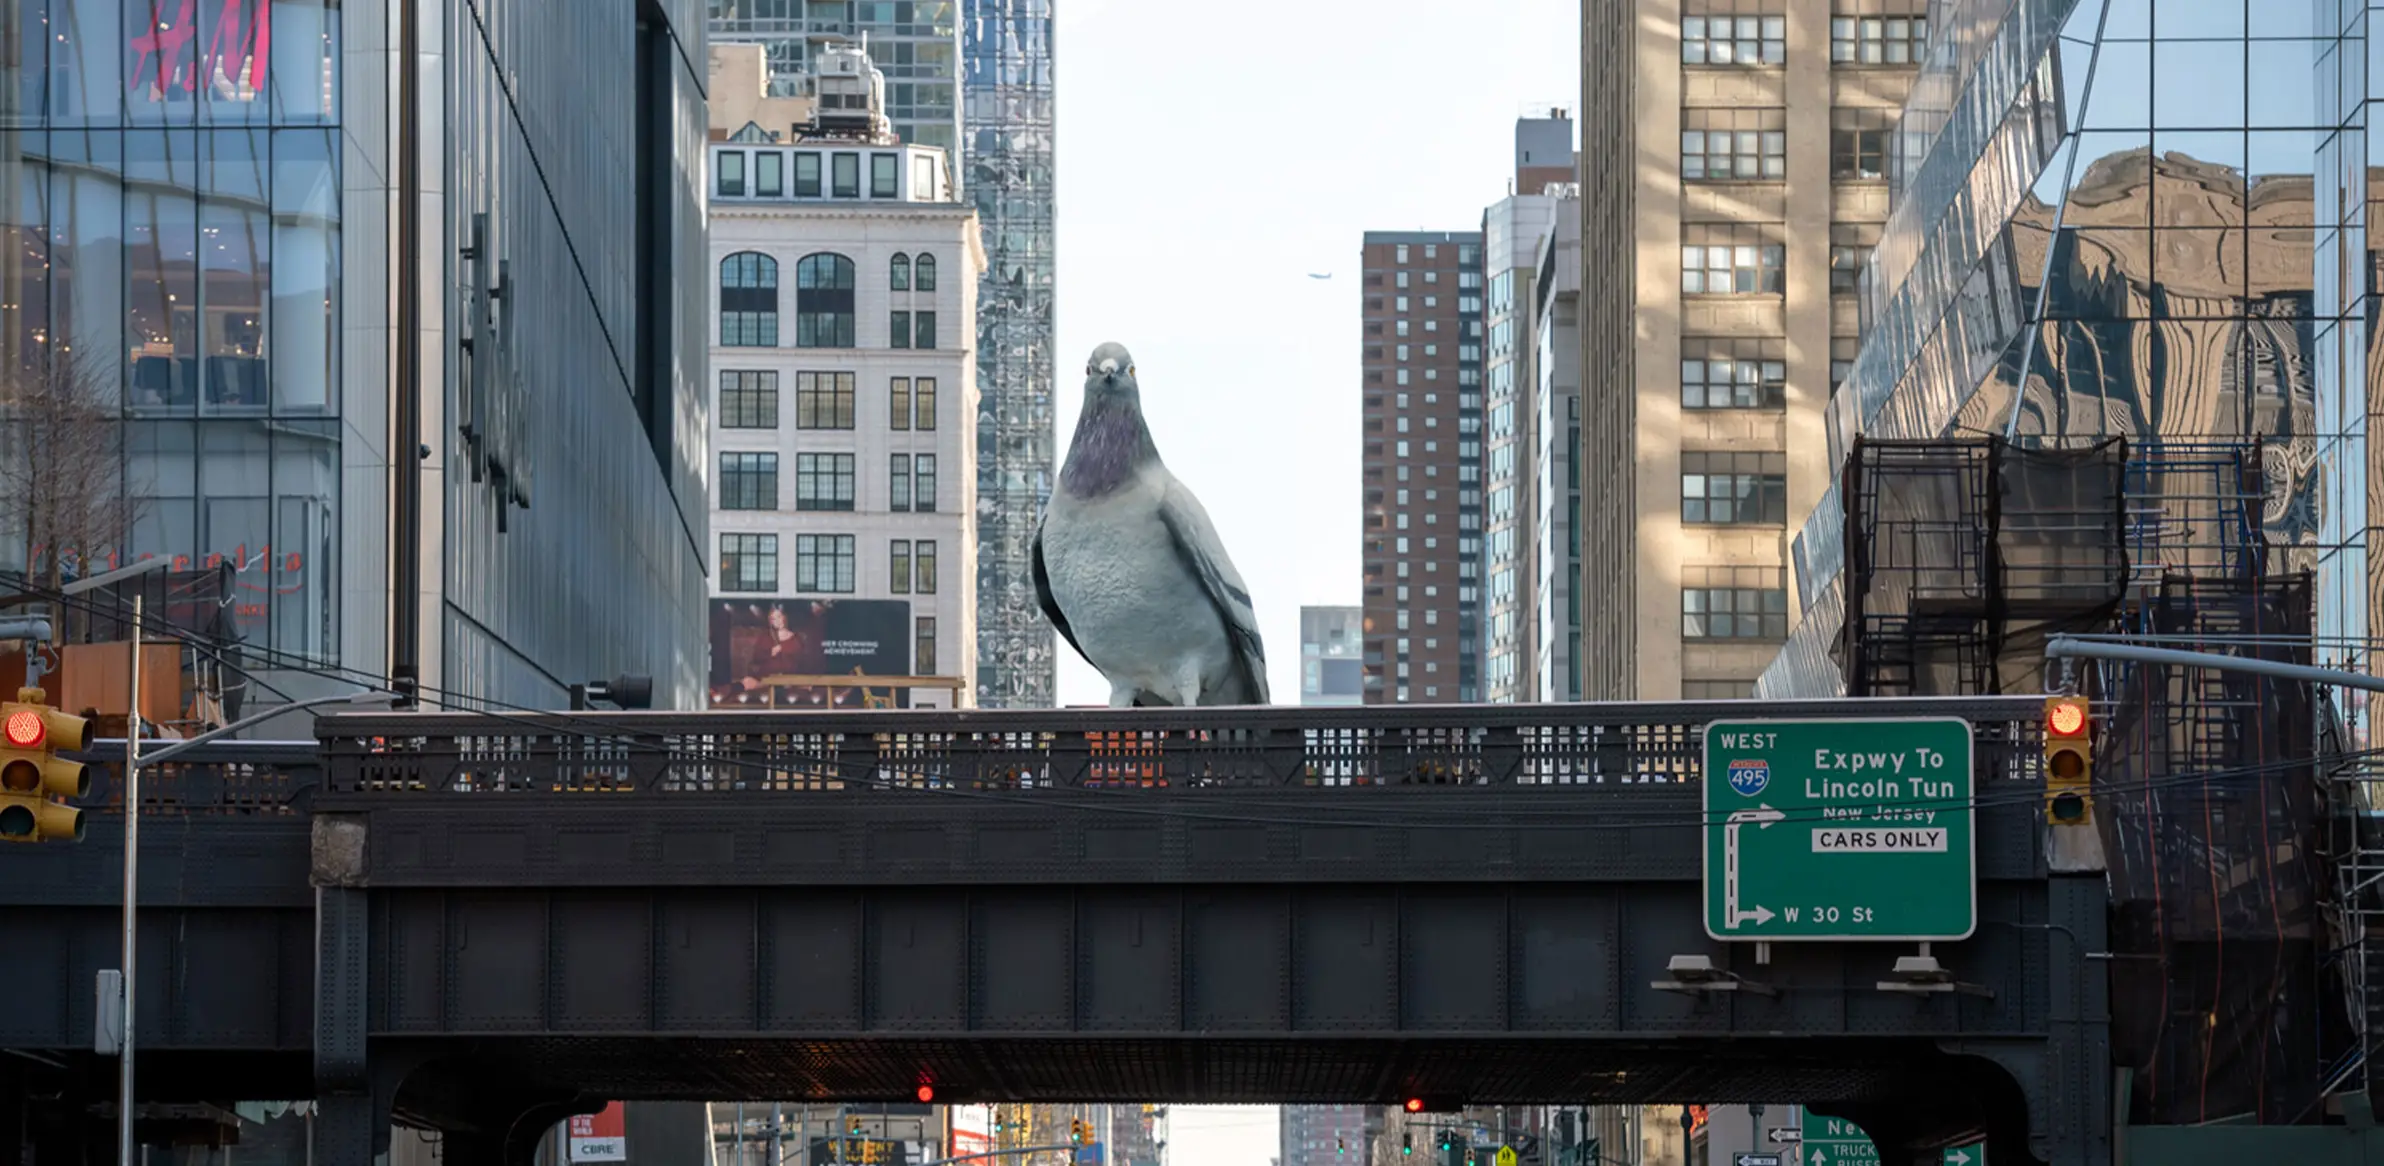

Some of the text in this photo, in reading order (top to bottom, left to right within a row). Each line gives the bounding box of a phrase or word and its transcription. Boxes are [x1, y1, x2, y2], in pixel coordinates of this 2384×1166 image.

[1721, 733, 1777, 749] WEST
[1815, 748, 1944, 774] Expwy To
[1731, 769, 1766, 787] 495
[1805, 777, 1955, 799] Lincoln Tun
[1823, 805, 1936, 825] New Jersey
[1820, 831, 1940, 848] CARS ONLY
[1784, 907, 1874, 922] W 30 St
[1828, 1120, 1865, 1136] Ne
[581, 1144, 614, 1155] CBRE
